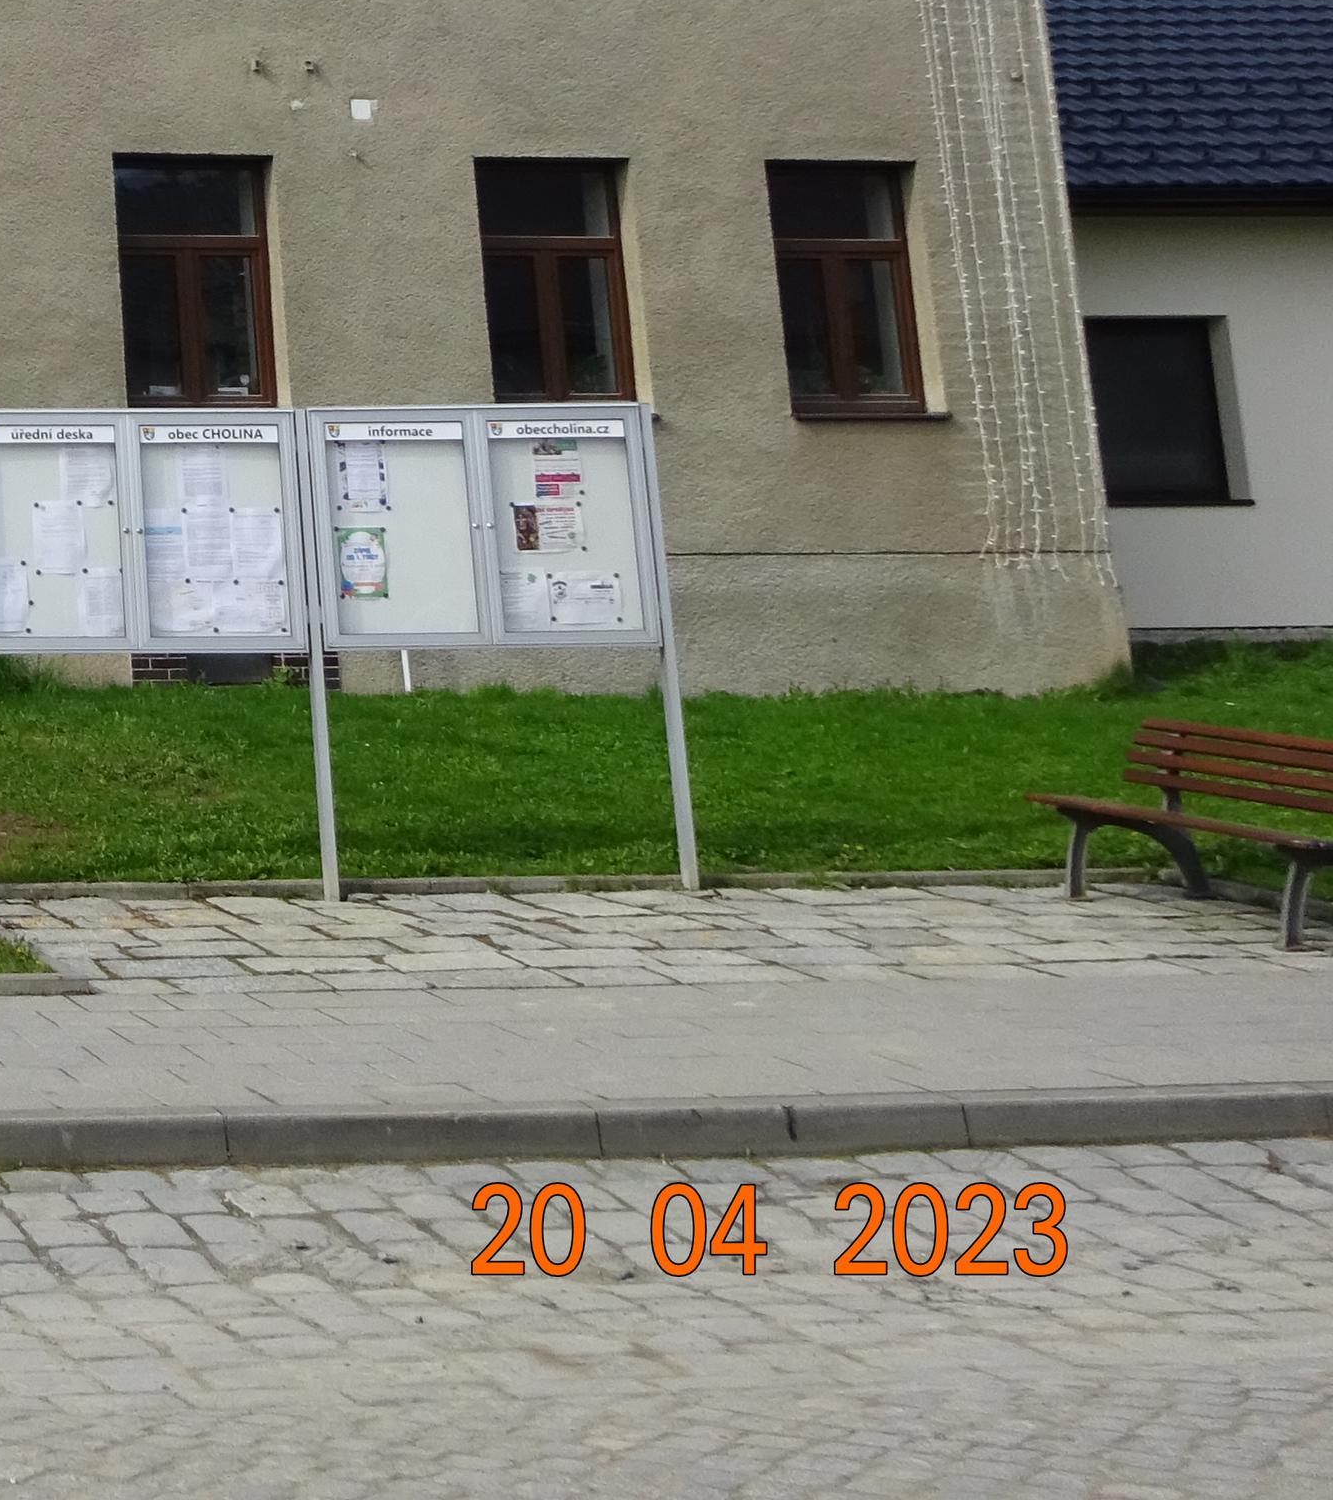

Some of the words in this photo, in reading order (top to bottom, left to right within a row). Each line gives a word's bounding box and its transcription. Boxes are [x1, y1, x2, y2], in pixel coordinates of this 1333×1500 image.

[10, 427, 53, 440] úřední
[57, 428, 94, 440] deska
[167, 429, 198, 440] obec
[202, 428, 264, 440] CHOLINA
[367, 425, 434, 438] informace
[515, 423, 611, 435] obeccholina.cz
